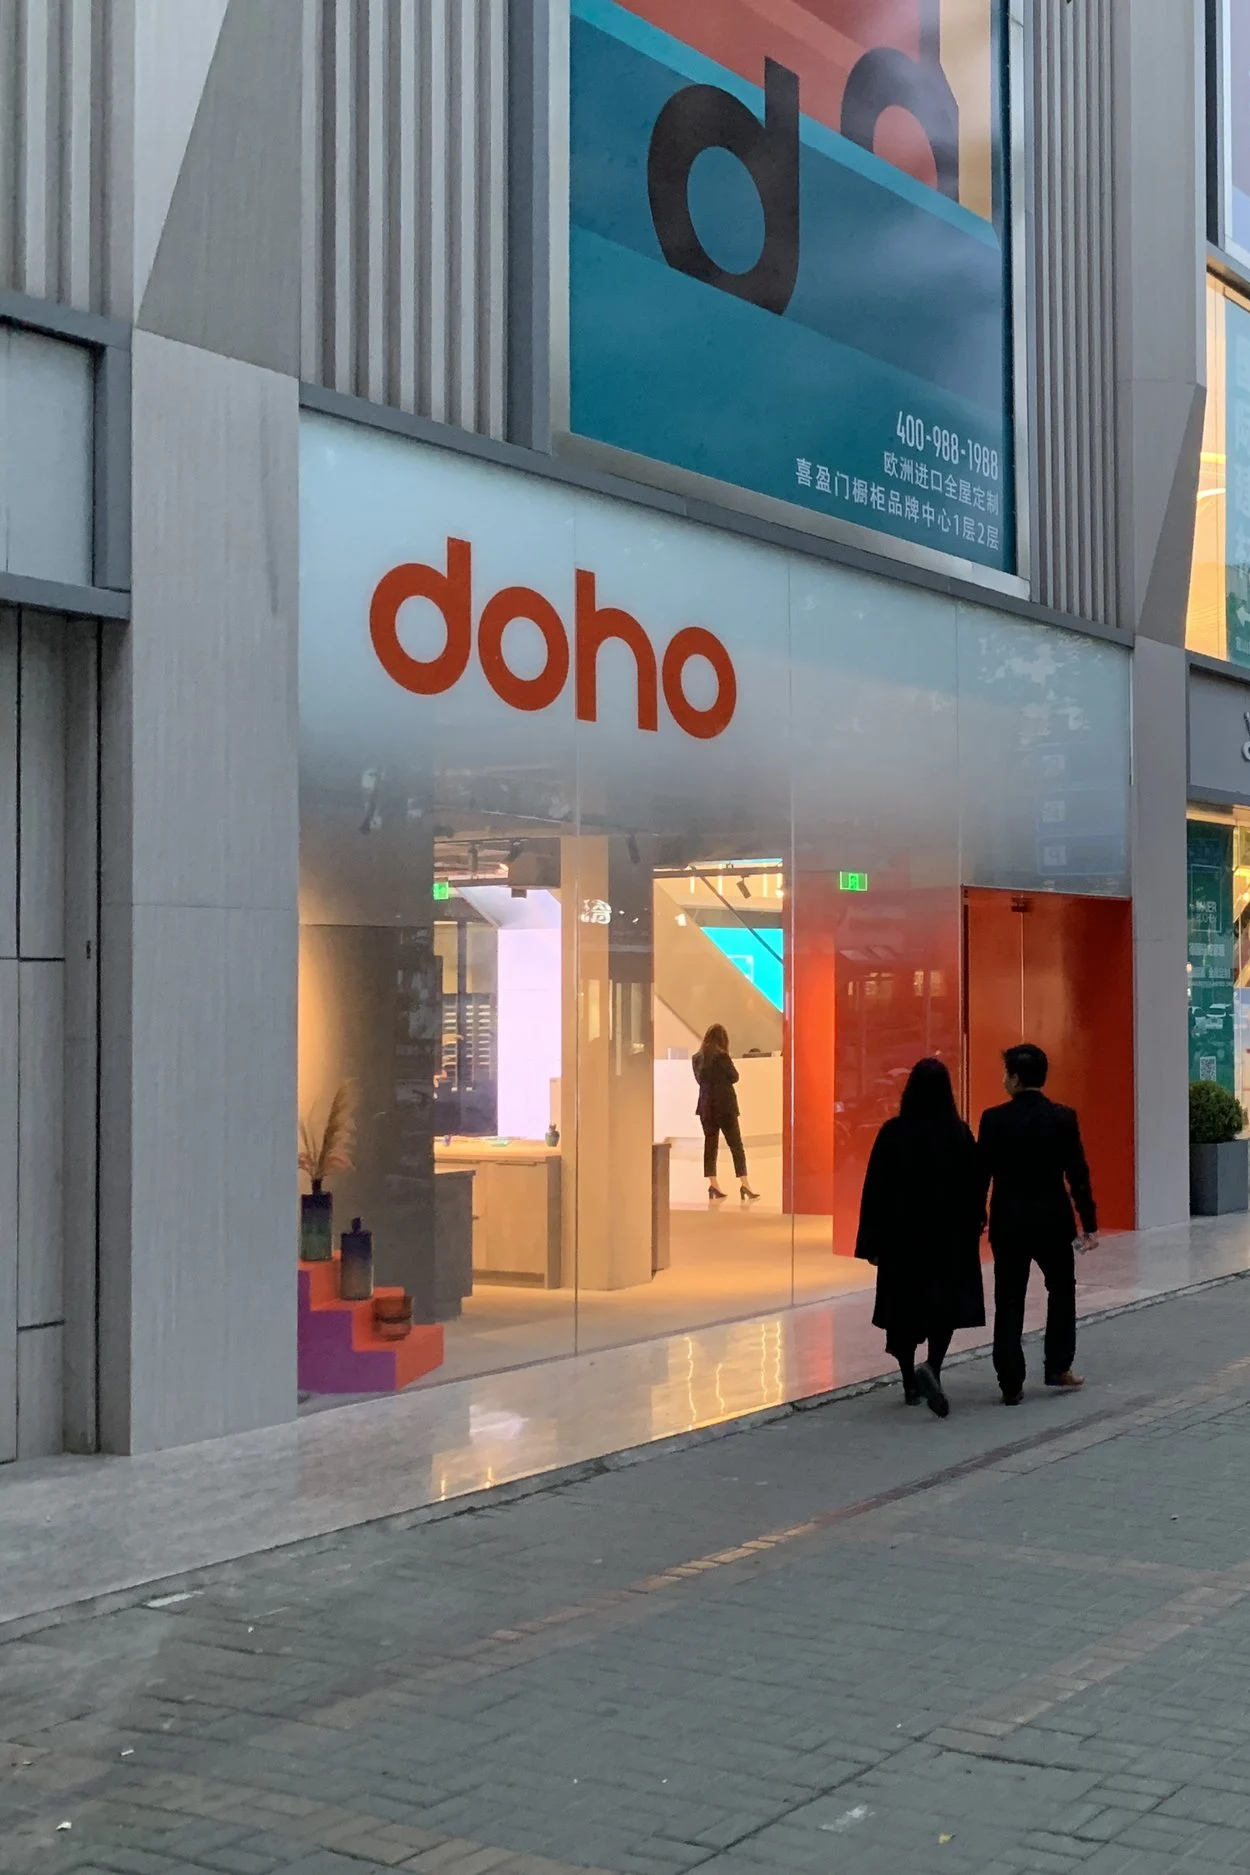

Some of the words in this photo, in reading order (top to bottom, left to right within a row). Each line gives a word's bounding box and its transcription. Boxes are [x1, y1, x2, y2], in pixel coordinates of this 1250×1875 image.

[882, 451, 1000, 517] 欧洲进口全屋定制
[895, 411, 1000, 481] 400-988-1988
[795, 457, 1000, 550] 喜盈门橱柜品牌中心1层2层
[369, 537, 737, 740] doho
